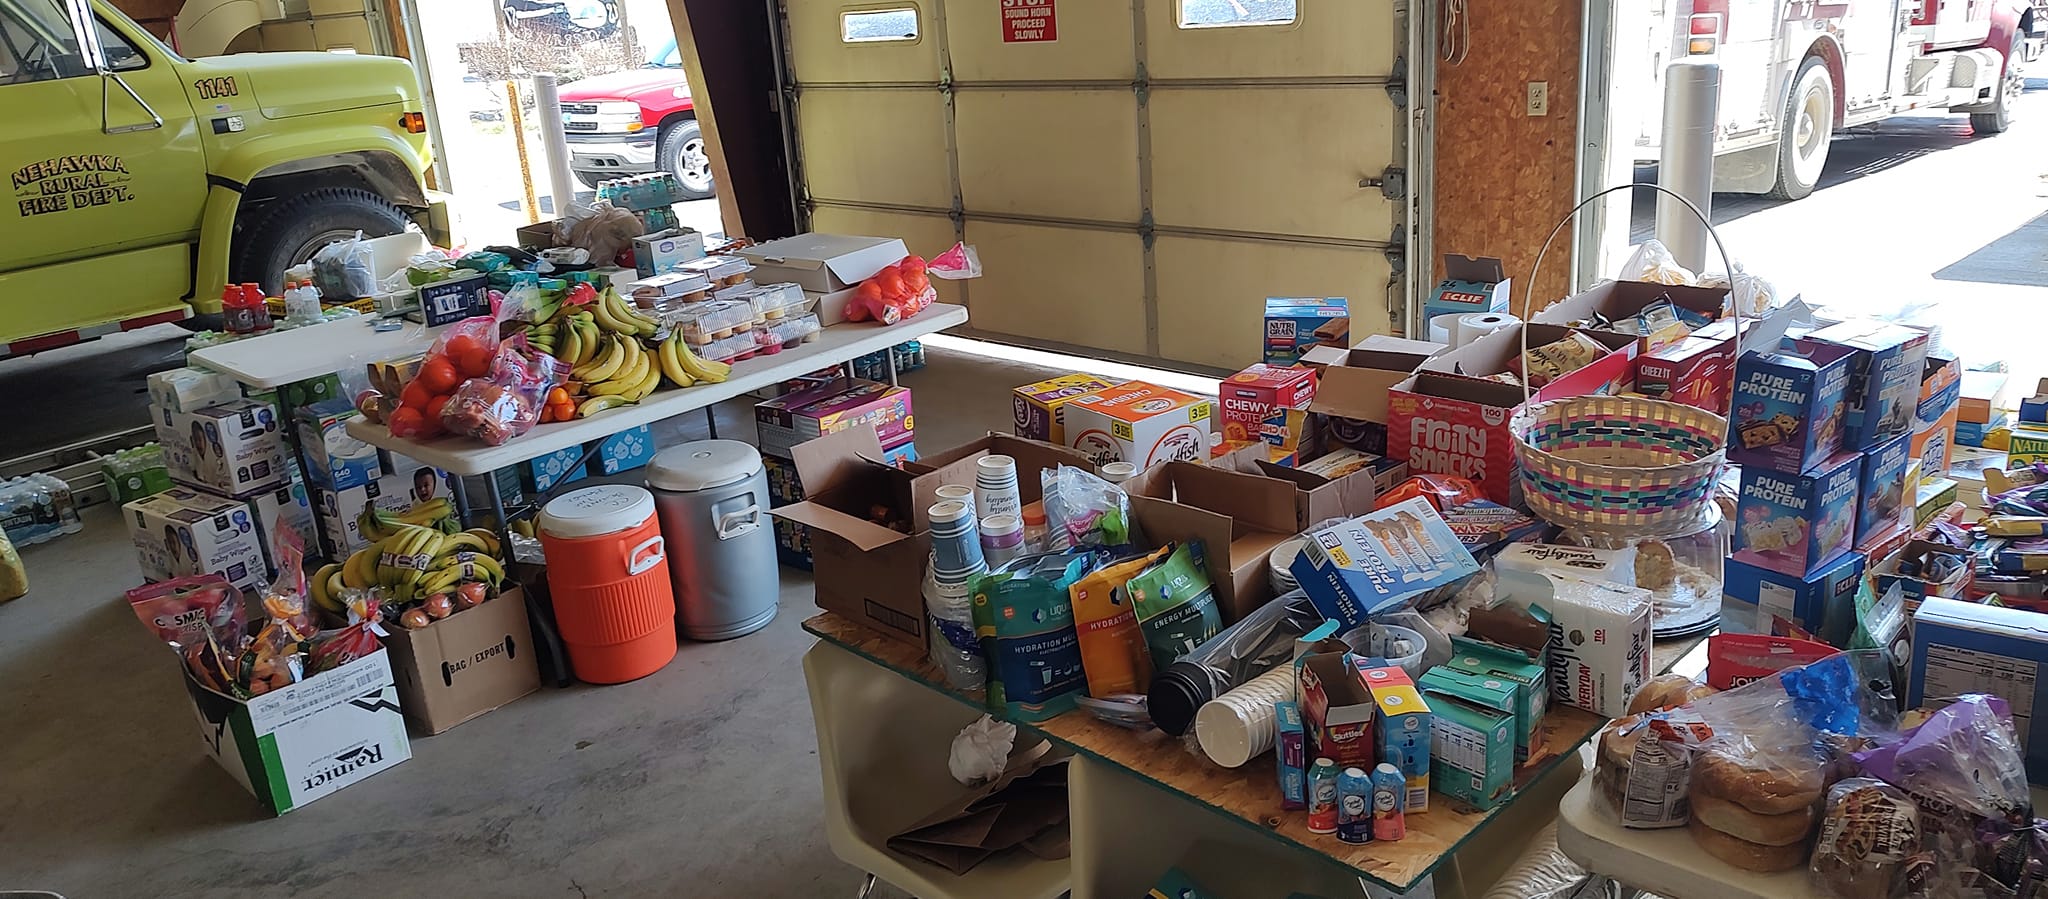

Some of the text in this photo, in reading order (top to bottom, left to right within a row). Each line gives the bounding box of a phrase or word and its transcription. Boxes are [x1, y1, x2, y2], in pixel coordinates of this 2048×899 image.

[1006, 8, 1051, 18] SOUND HORN
[1012, 19, 1046, 28] PROCEED
[1015, 30, 1044, 40] SLOWLY
[194, 76, 238, 99] 1141
[11, 153, 130, 190] NEHAWKA
[40, 172, 107, 196] RURAL
[18, 183, 136, 217] FIRE DEPT.
[1750, 372, 1794, 390] PURE
[1826, 362, 1847, 384] PURE
[1294, 384, 1313, 400] CHEWY
[1738, 381, 1806, 404] PROTEIN
[1818, 375, 1850, 402] PROTEIN
[1192, 408, 1198, 418] 3
[1225, 398, 1270, 412] CHEWY
[1485, 408, 1500, 417] 100
[1226, 410, 1262, 424] PROTE
[1114, 424, 1120, 434] 3
[236, 445, 275, 462] Baby Wipes
[1880, 442, 1902, 464] PURE
[334, 468, 350, 478] 640
[1828, 467, 1852, 490] PURE
[1744, 484, 1807, 510] PROTEIN
[1756, 476, 1794, 496] PURE
[1821, 478, 1856, 507] PROTEIN
[210, 546, 252, 566] Baby Wipes
[1349, 528, 1396, 584] PROTEIN
[1359, 559, 1390, 595] PURE
[1327, 572, 1357, 615] PROTEIN
[1050, 604, 1067, 616] LIQU
[1154, 593, 1214, 630] ENERGY MULTIPLIER
[1336, 600, 1357, 626] PURE
[1015, 640, 1060, 654] HYDRATION
[450, 642, 505, 675] BAG / EXPORT
[1629, 654, 1643, 688] anity
[1579, 662, 1591, 710] EVERYDAY
[1332, 729, 1364, 742] Skittles
[304, 743, 384, 792] Rainier
